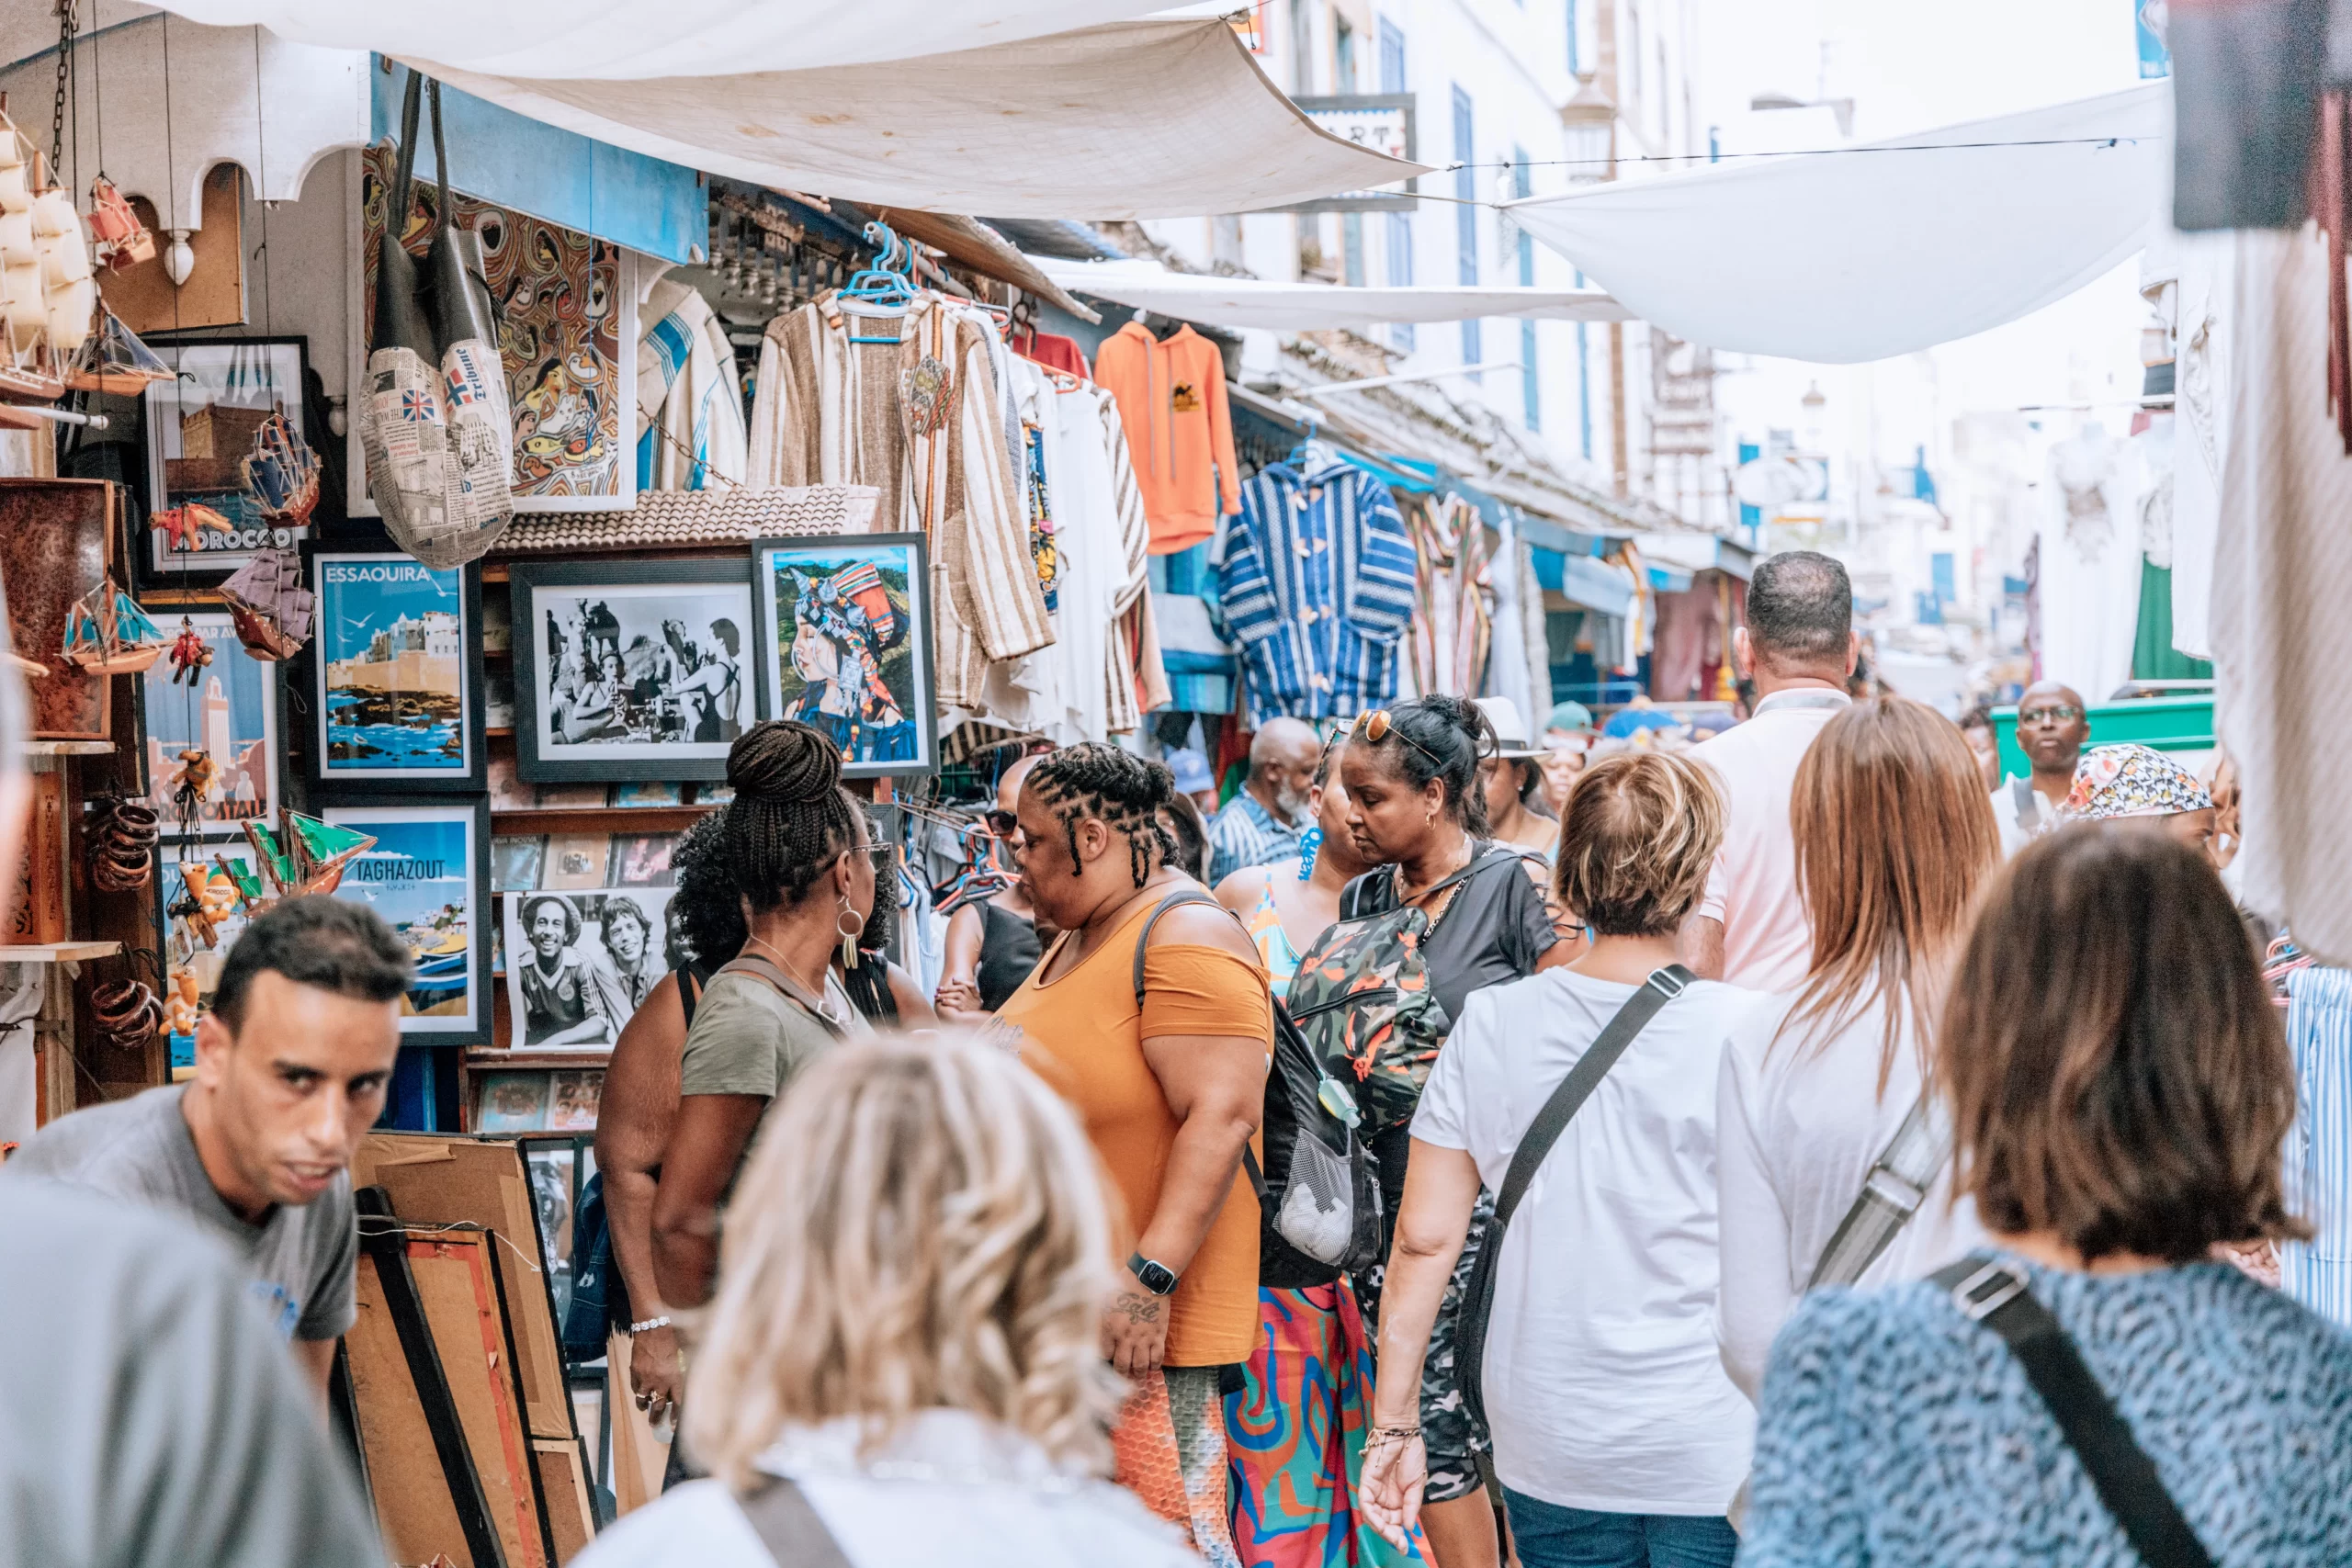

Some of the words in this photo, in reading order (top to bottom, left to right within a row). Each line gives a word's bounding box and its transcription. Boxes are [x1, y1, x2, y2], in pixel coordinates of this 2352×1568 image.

[1328, 125, 1389, 145] RT
[456, 349, 486, 400] Tribune
[326, 566, 430, 582] ESSAOUIRA
[1298, 827, 1324, 880] Queen
[356, 860, 445, 881] TAGHAZOUT
